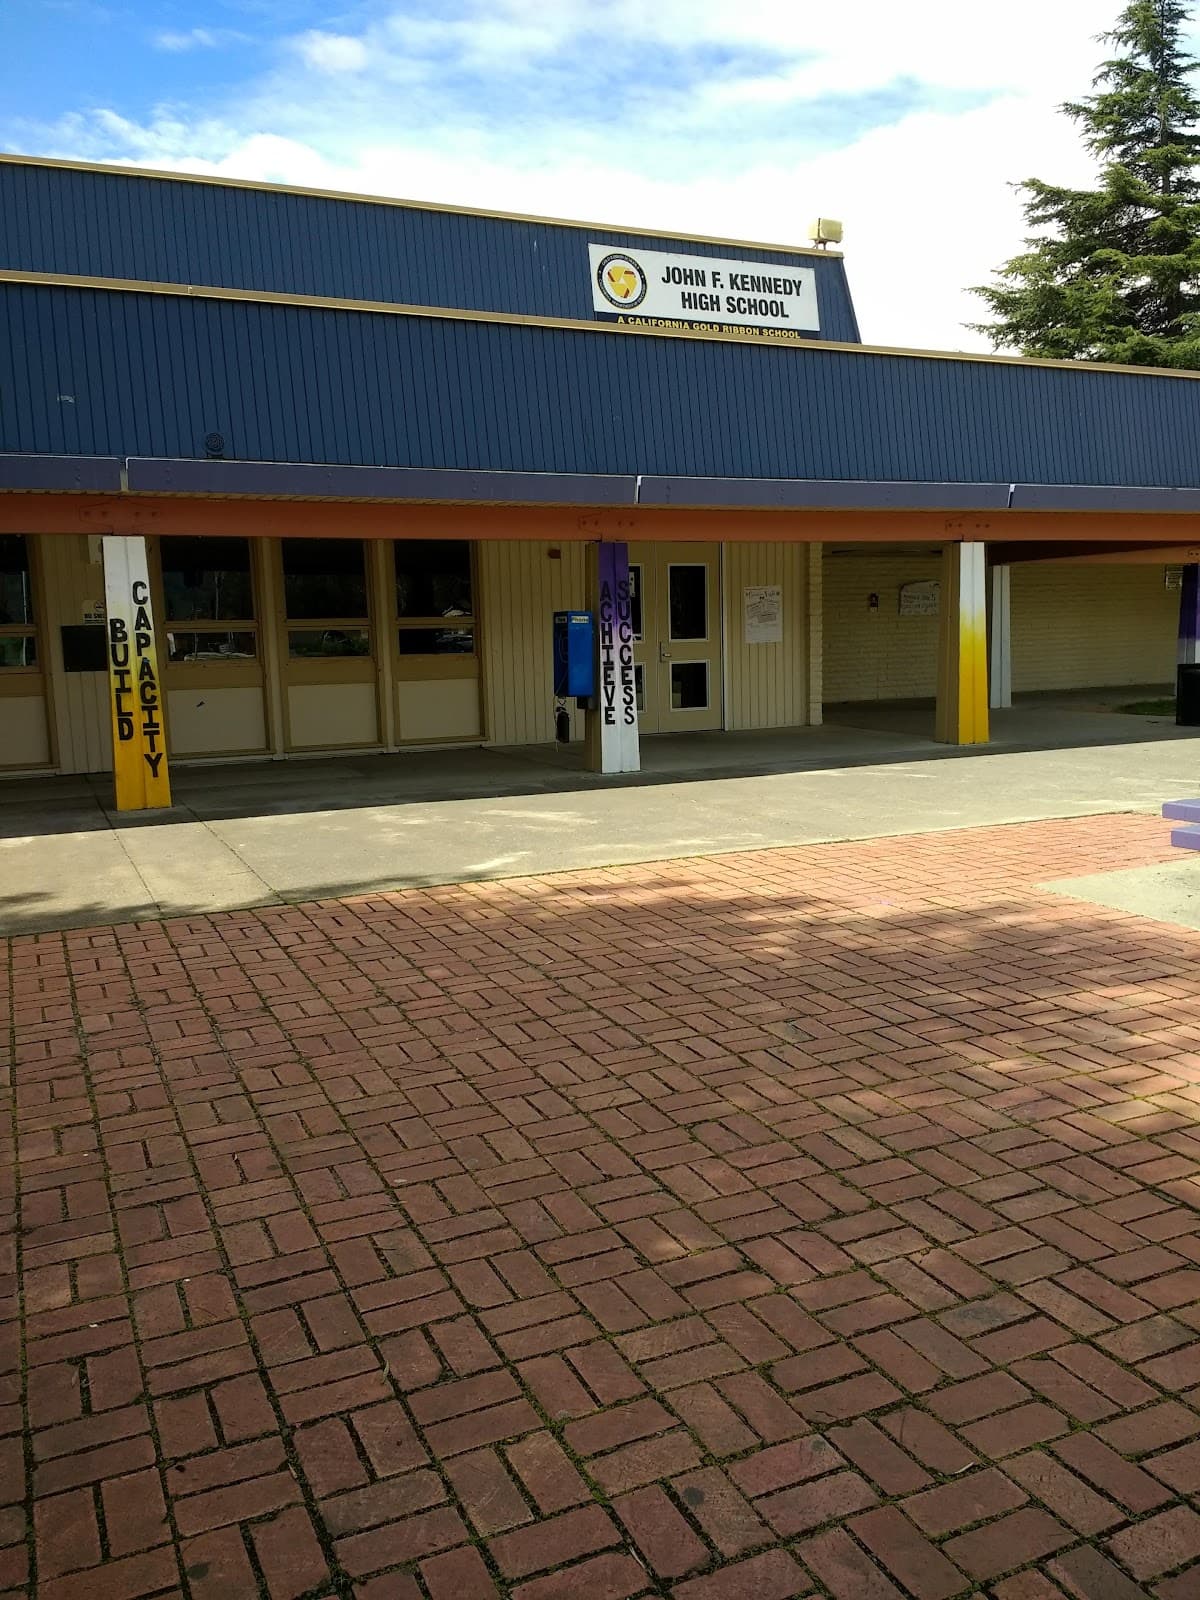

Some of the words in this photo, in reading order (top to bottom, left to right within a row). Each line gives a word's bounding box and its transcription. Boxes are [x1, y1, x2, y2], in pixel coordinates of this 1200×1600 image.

[617, 315, 625, 324] A
[628, 316, 690, 330] CALIFORNIA
[693, 322, 719, 332] GOLD
[722, 324, 760, 336] RIBBON
[762, 328, 801, 339] SCHOOL
[661, 266, 706, 287] JOHN
[711, 271, 724, 289] F.
[729, 273, 802, 296] KENNEDY
[681, 292, 721, 312] HIGH
[726, 296, 789, 318] SCHOOL
[109, 618, 134, 741] BUILD
[132, 581, 163, 778] CAPACITY
[600, 580, 616, 725] ACHIEVE
[617, 580, 635, 725] SUCCESS
